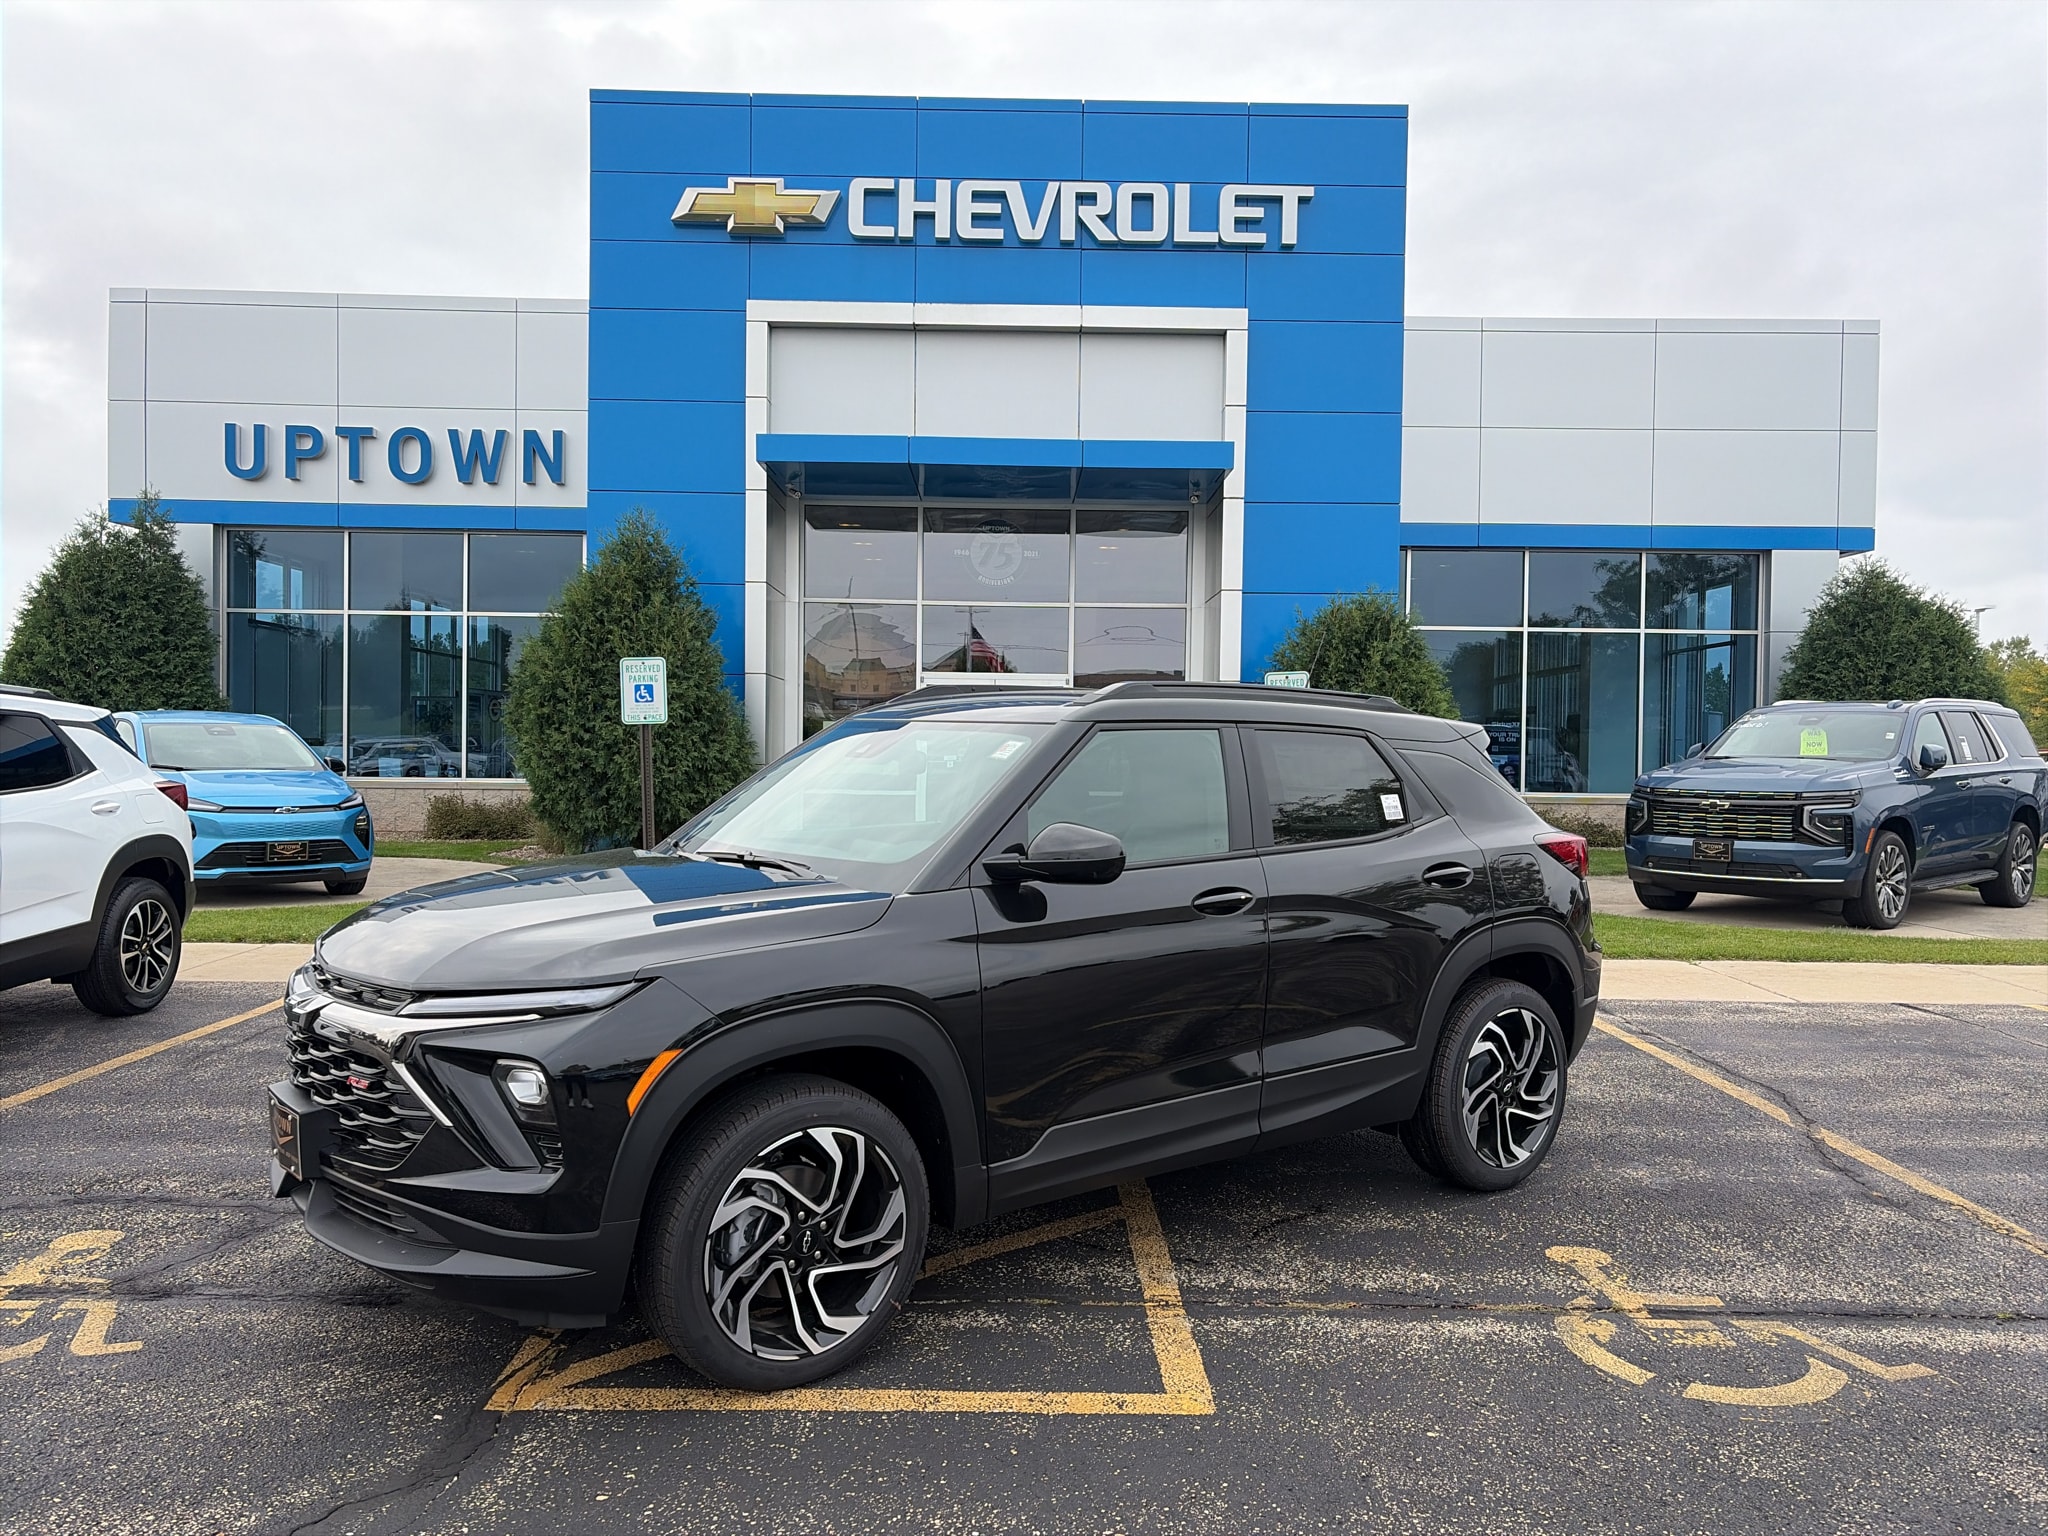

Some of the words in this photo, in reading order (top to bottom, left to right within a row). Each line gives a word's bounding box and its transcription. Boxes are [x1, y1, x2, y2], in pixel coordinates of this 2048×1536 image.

[848, 177, 1315, 248] CHEVROLET
[223, 422, 566, 486] UPTOWN
[979, 541, 1014, 570] 75
[1023, 549, 1039, 558] 2021
[977, 574, 1015, 587] ANNIVERSARY
[625, 664, 661, 673] RESERVED
[628, 674, 659, 683] PARKING
[1269, 678, 1305, 688] RESERVED
[626, 713, 641, 721] THIS
[643, 713, 663, 721] SPACE
[345, 1075, 370, 1090] RS
